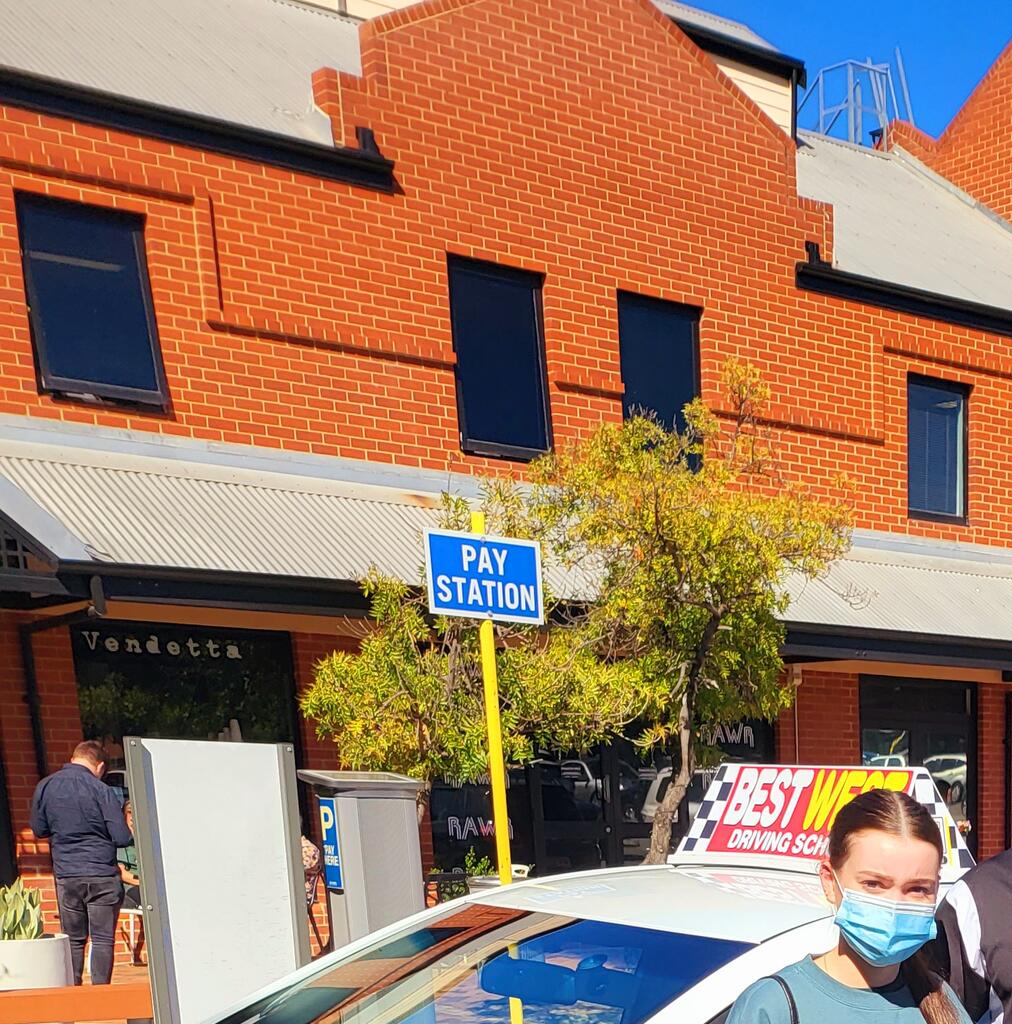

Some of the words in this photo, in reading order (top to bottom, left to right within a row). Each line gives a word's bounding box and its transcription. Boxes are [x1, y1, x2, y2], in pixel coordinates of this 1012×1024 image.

[461, 544, 508, 576] PAY
[436, 575, 536, 612] STATION
[81, 631, 242, 660] Vendetta
[723, 767, 814, 829] BEST
[320, 805, 334, 841] P
[323, 844, 335, 856] PAY
[727, 828, 793, 853] DRIVING
[791, 833, 831, 856] SCH
